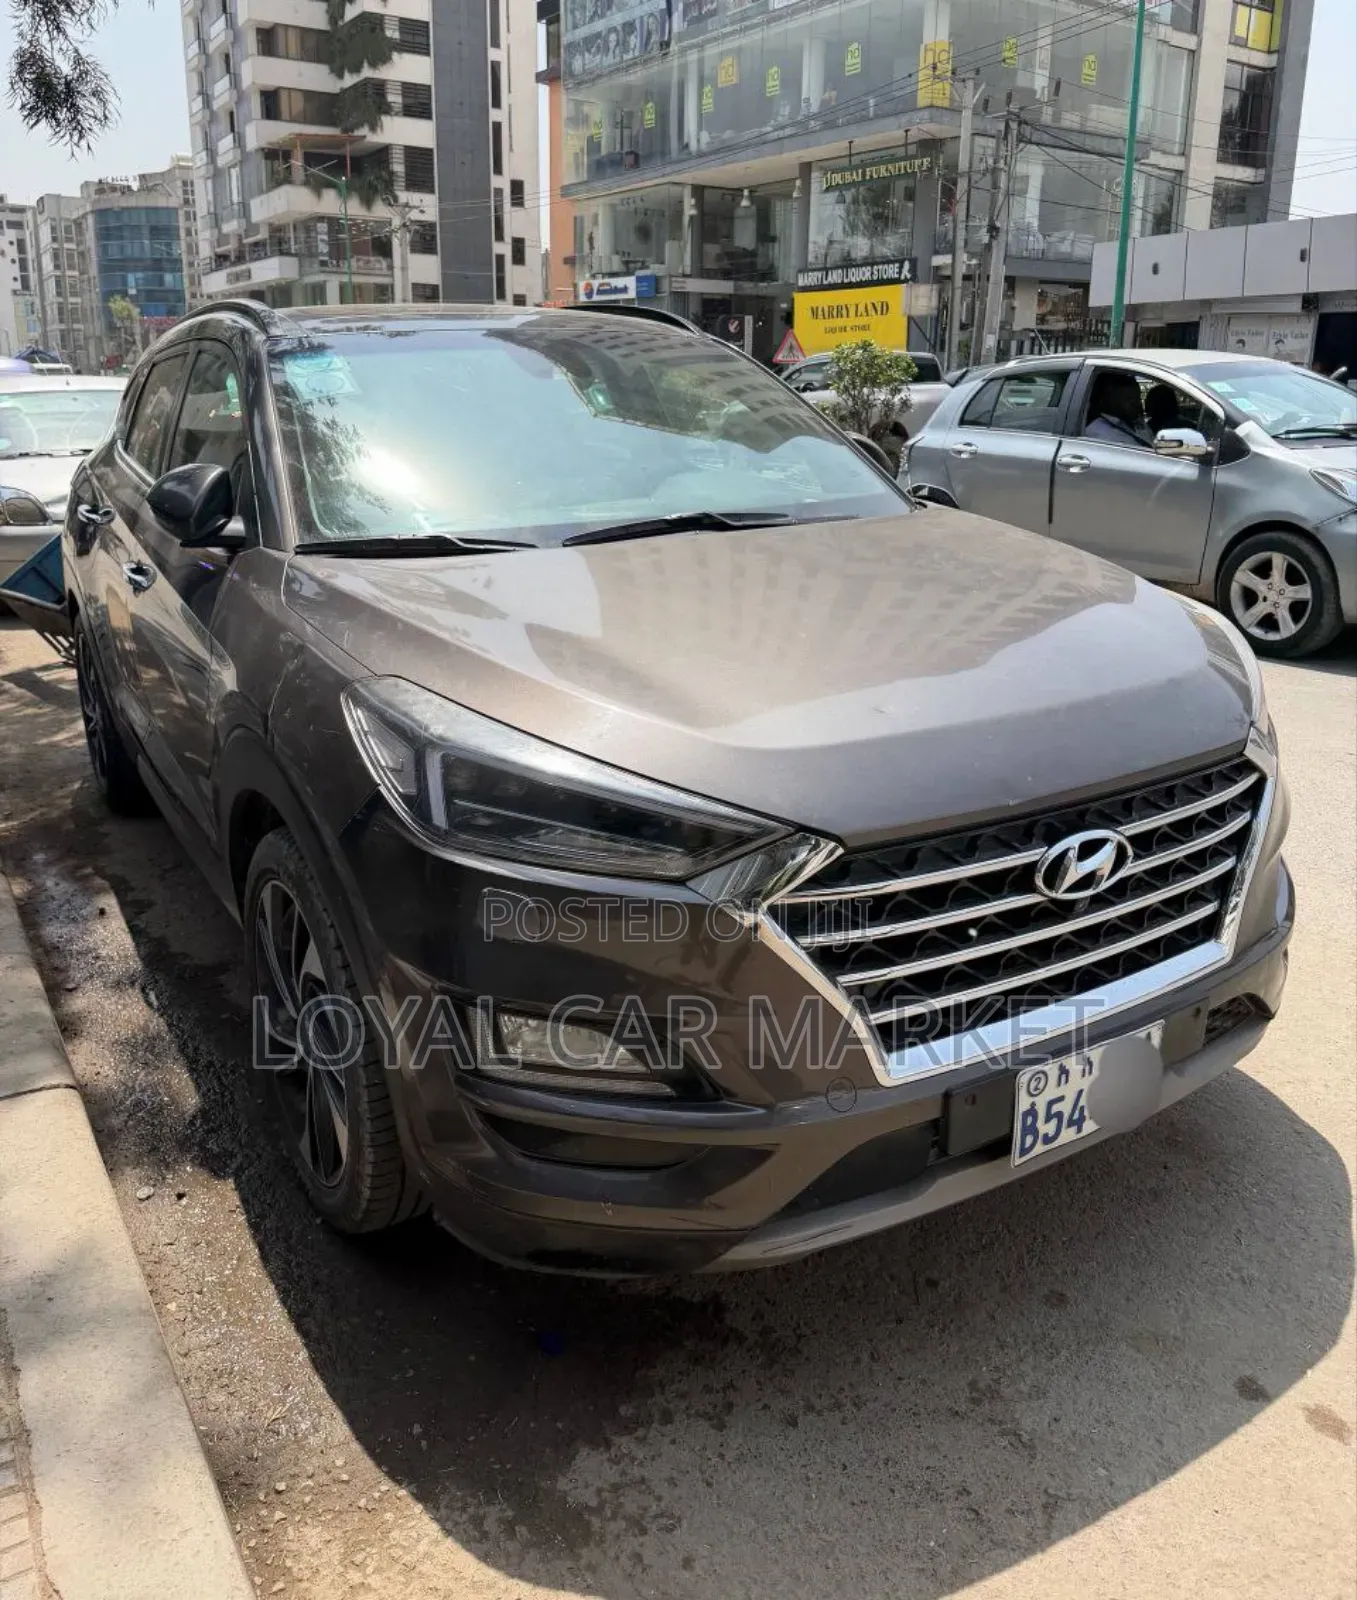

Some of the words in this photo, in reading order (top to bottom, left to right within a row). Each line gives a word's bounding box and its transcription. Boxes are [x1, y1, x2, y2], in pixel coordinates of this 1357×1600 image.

[831, 169, 863, 186] DUBAI
[798, 271, 822, 287] MARRY
[822, 269, 843, 284] LAND
[843, 266, 872, 283] LIQUOR
[872, 263, 900, 280] STORE
[810, 303, 852, 320] MARRY
[854, 301, 889, 317] LAND
[850, 324, 871, 332] STORE
[1018, 1087, 1087, 1158] B54
